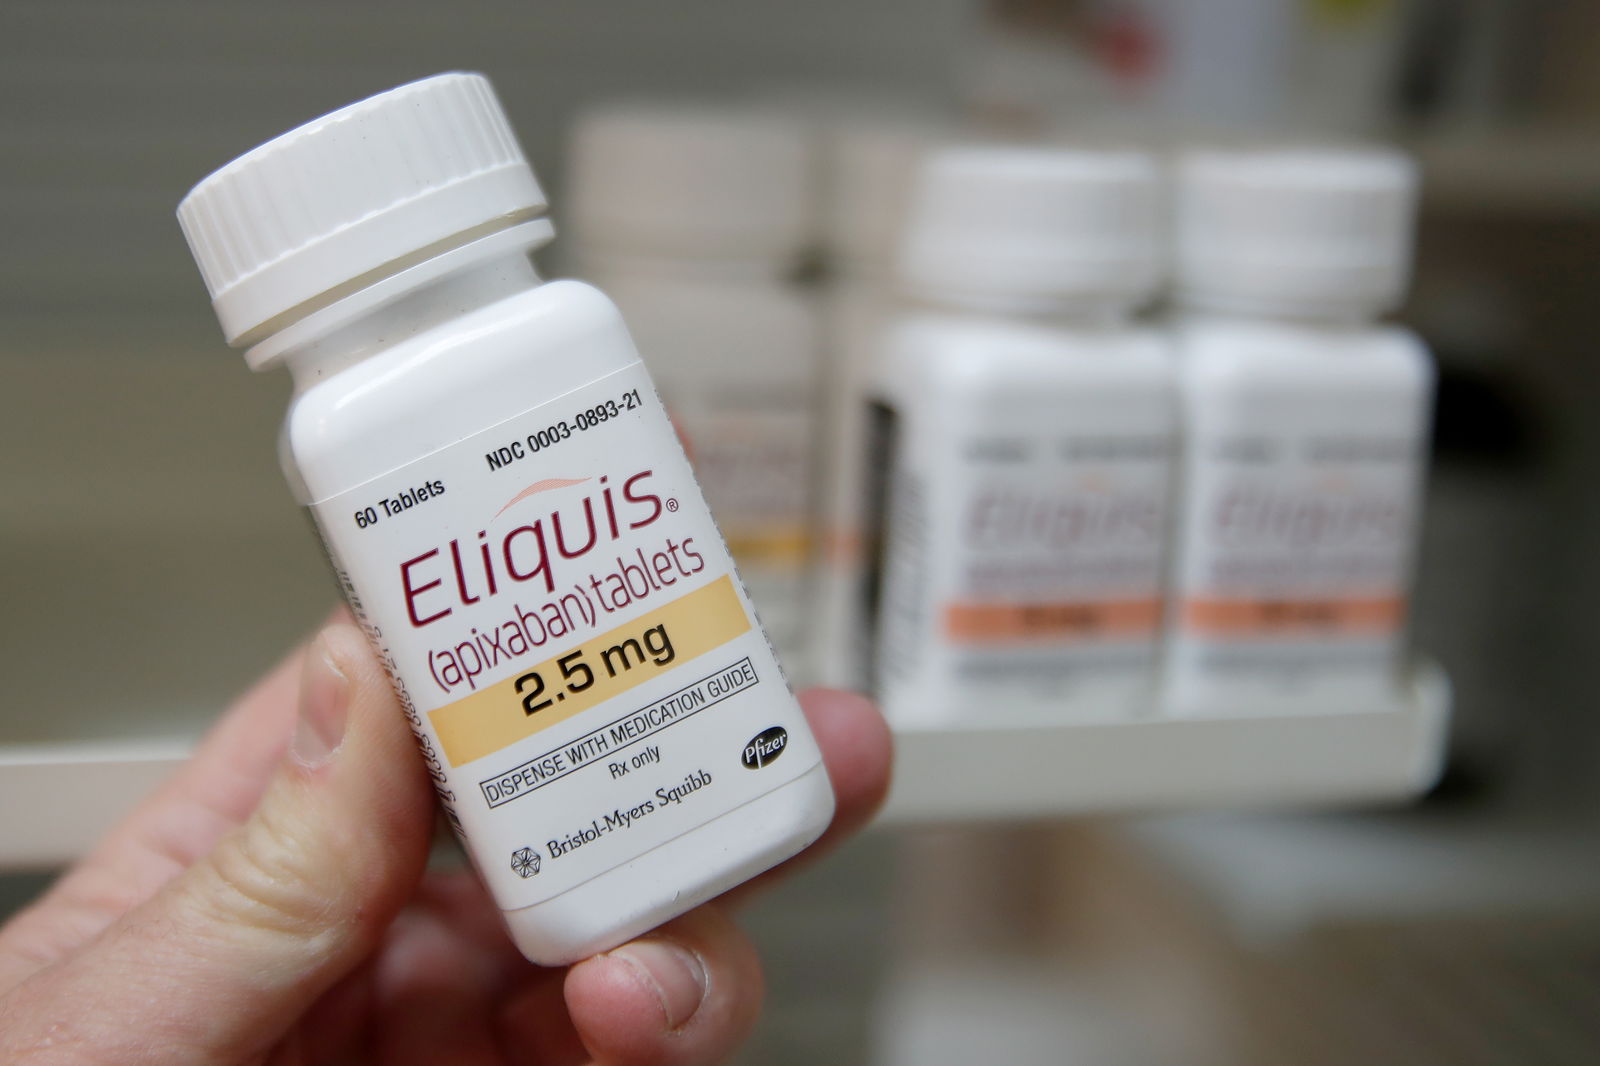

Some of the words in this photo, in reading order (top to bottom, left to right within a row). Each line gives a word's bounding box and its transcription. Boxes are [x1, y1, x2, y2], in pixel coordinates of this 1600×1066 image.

[485, 441, 525, 472] NDC
[527, 388, 643, 452] 0003-0893-21
[354, 506, 378, 529] 60
[379, 480, 445, 518] Tablets
[428, 584, 597, 694] (apixaban)
[590, 537, 705, 613] tablets
[514, 649, 595, 717] 2.5
[600, 623, 676, 678] mg
[486, 755, 567, 803] DISPENSE
[564, 734, 608, 767] WITH
[609, 687, 706, 745] MEDICATION
[707, 664, 755, 698] GUIDE
[608, 762, 631, 780] Rx
[631, 744, 661, 768] only
[743, 731, 787, 770] Pfizer
[546, 800, 655, 859] Bristol-Myers
[655, 768, 712, 809] Squibb
